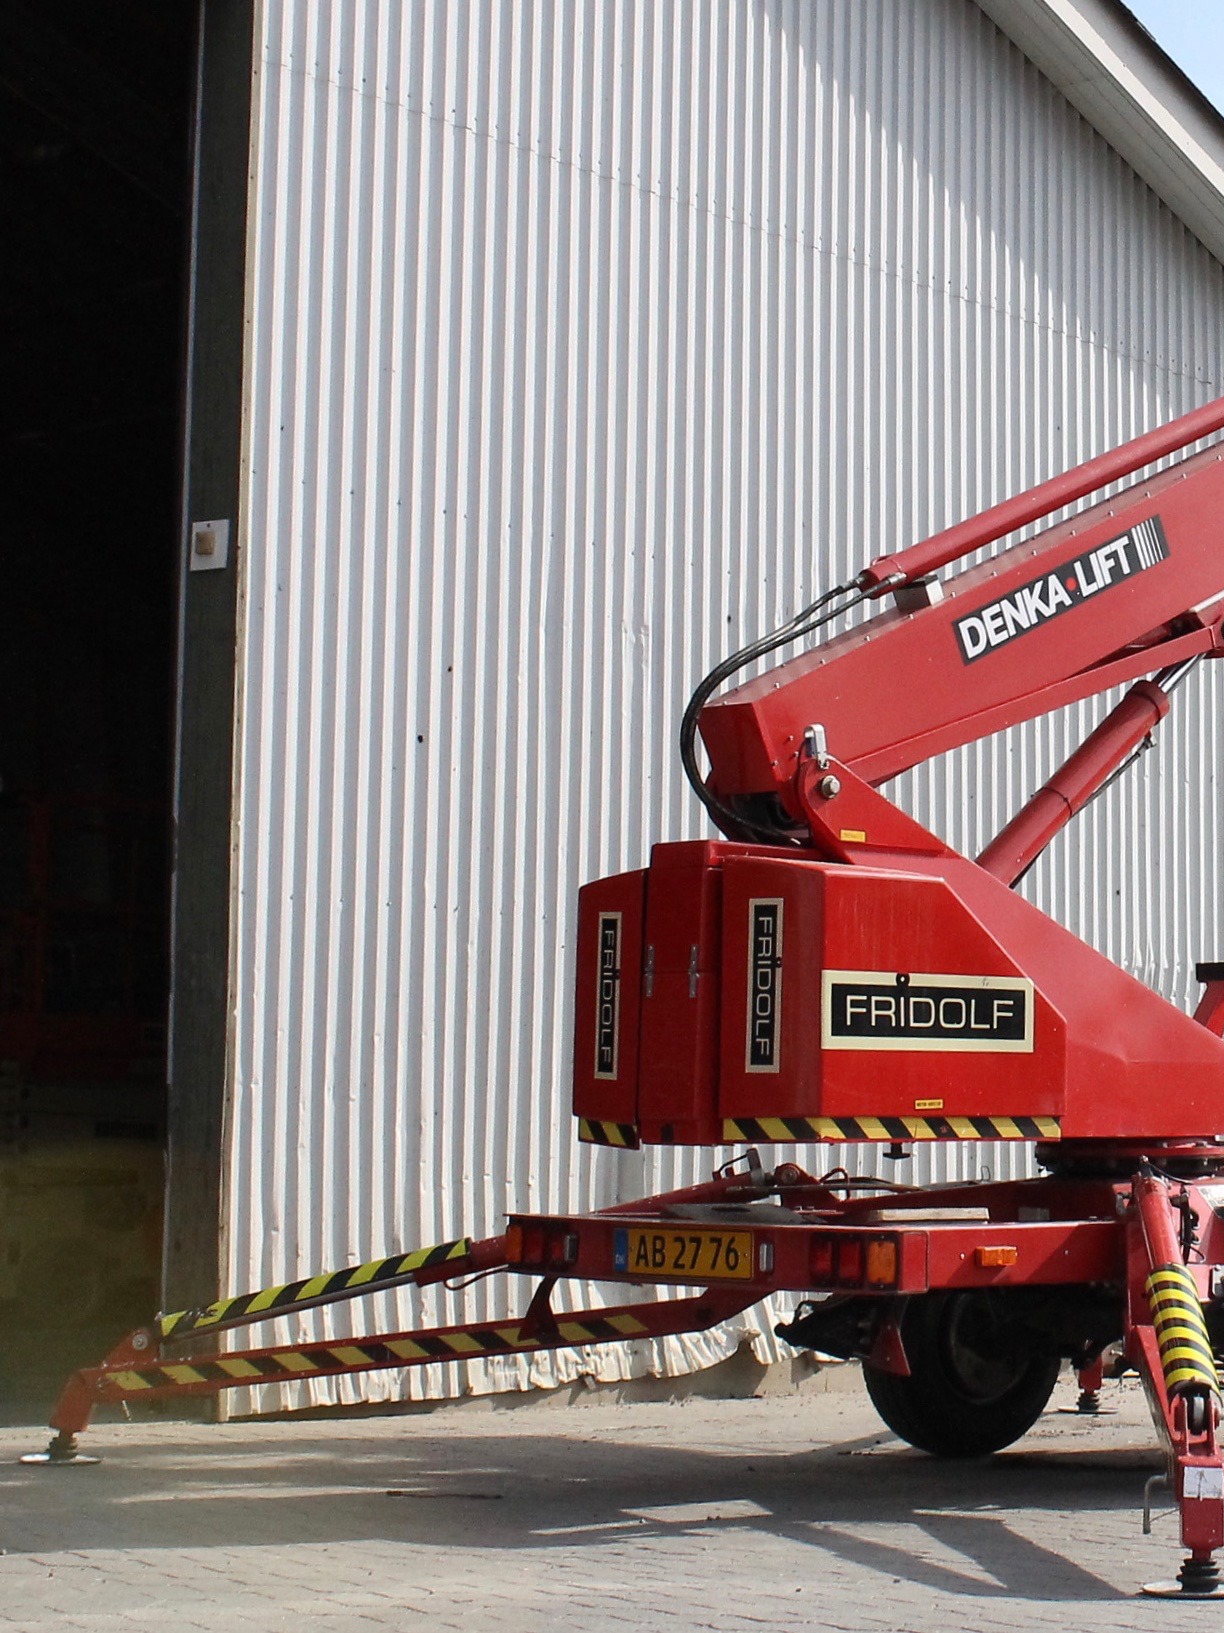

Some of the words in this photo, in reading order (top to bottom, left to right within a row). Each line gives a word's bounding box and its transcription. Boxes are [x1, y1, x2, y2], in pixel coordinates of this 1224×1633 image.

[958, 573, 1073, 660] DENKA
[1073, 535, 1131, 598] LIFT
[601, 930, 615, 1063] FRIDOLF
[755, 916, 773, 1056] FRIDOLF
[845, 994, 1015, 1030] FRIDOLF
[635, 1235, 666, 1268] AB
